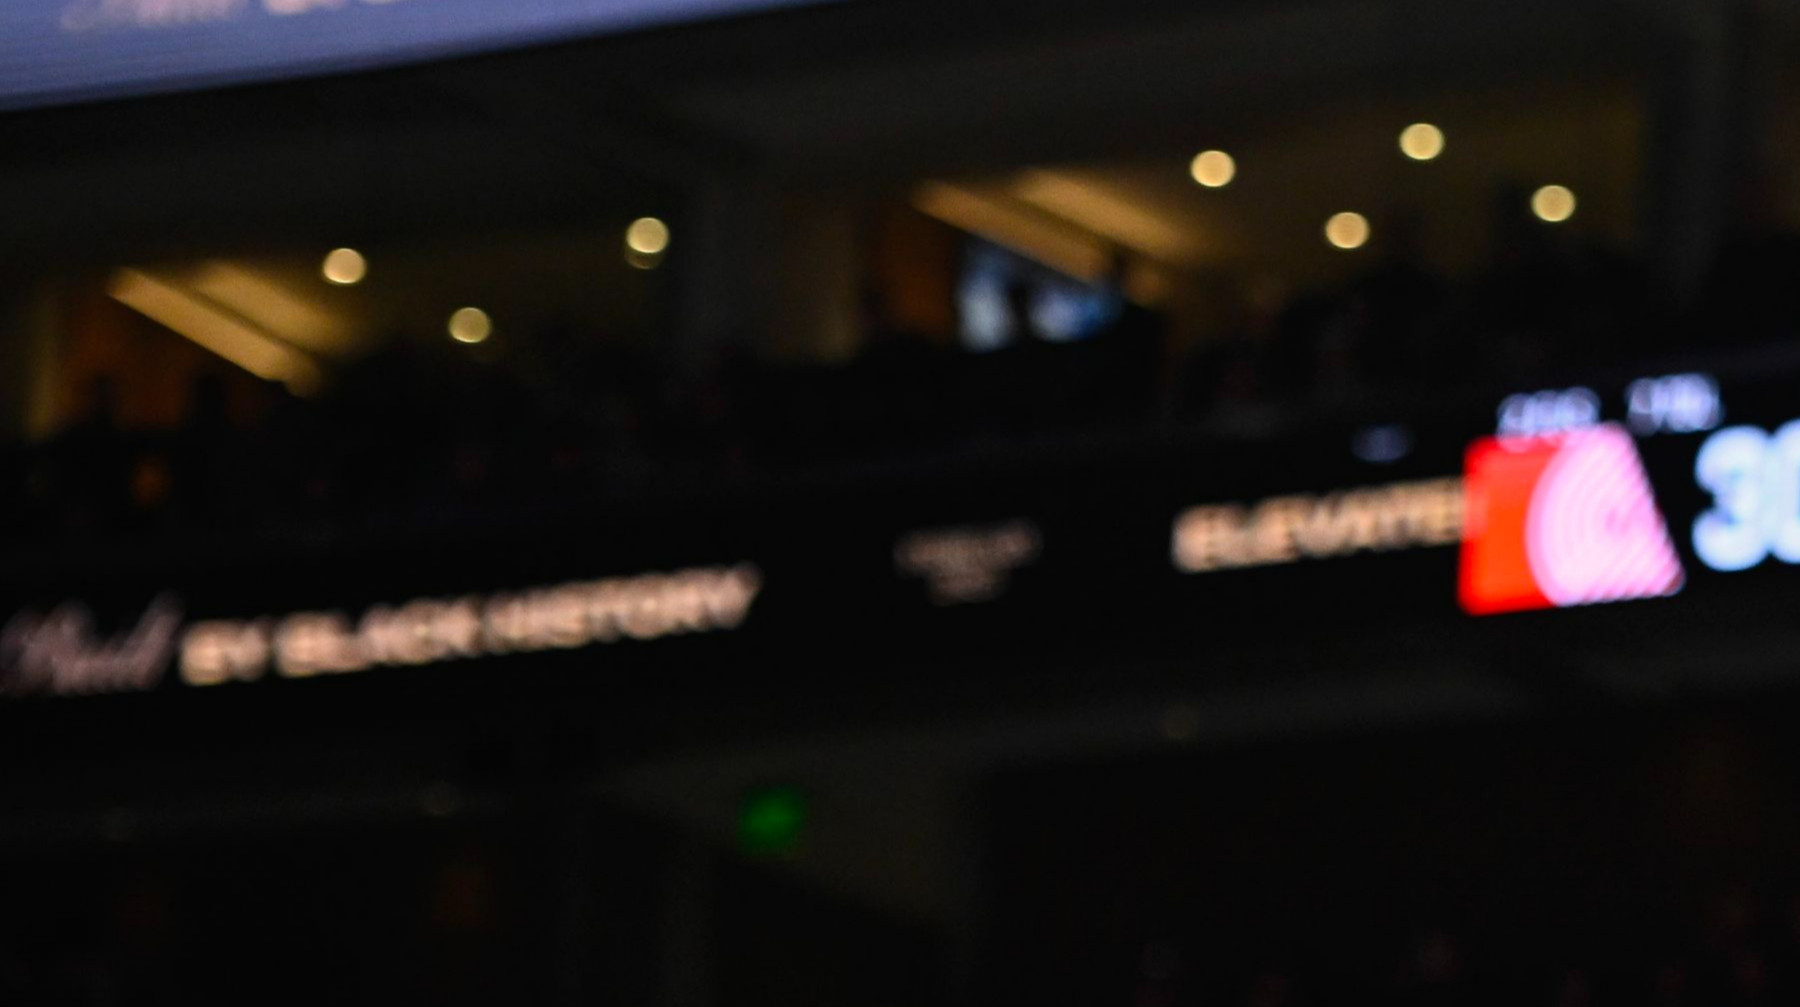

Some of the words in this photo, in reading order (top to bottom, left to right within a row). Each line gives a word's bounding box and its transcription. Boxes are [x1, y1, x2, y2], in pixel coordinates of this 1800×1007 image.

[180, 618, 270, 686] BY
[273, 596, 482, 678] BLACK
[484, 562, 760, 654] HISTORY
